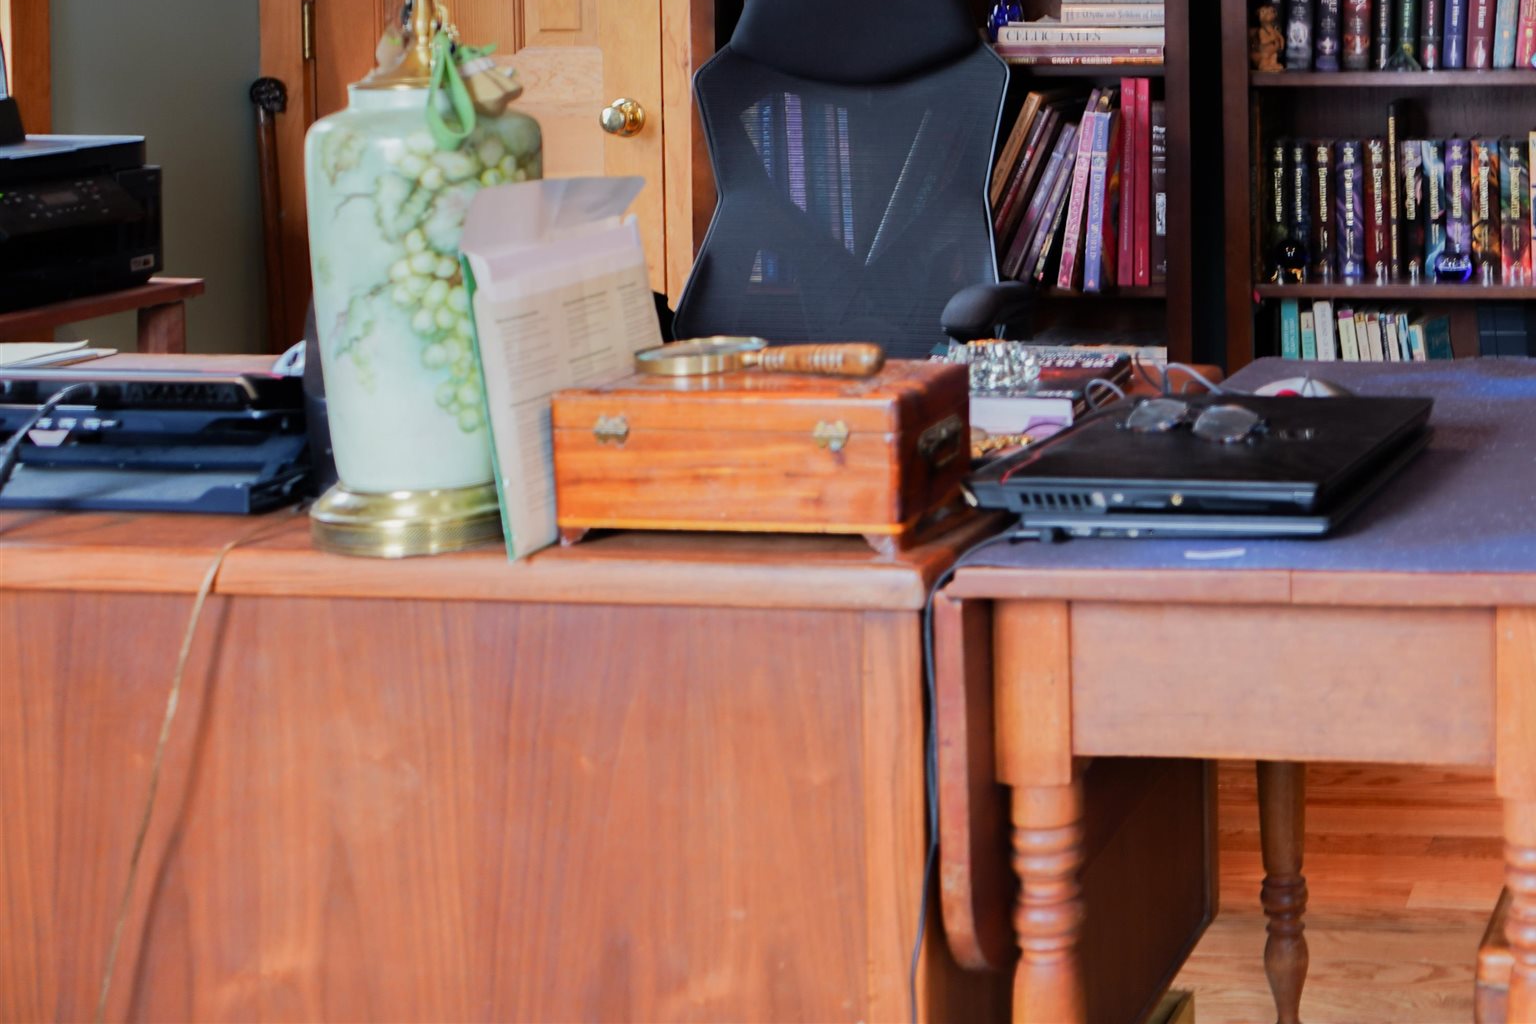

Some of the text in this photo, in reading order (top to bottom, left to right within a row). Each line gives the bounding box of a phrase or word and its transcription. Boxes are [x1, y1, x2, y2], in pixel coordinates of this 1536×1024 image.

[1006, 31, 1102, 43] CELTIC TALES
[1089, 222, 1102, 261] WORLD
